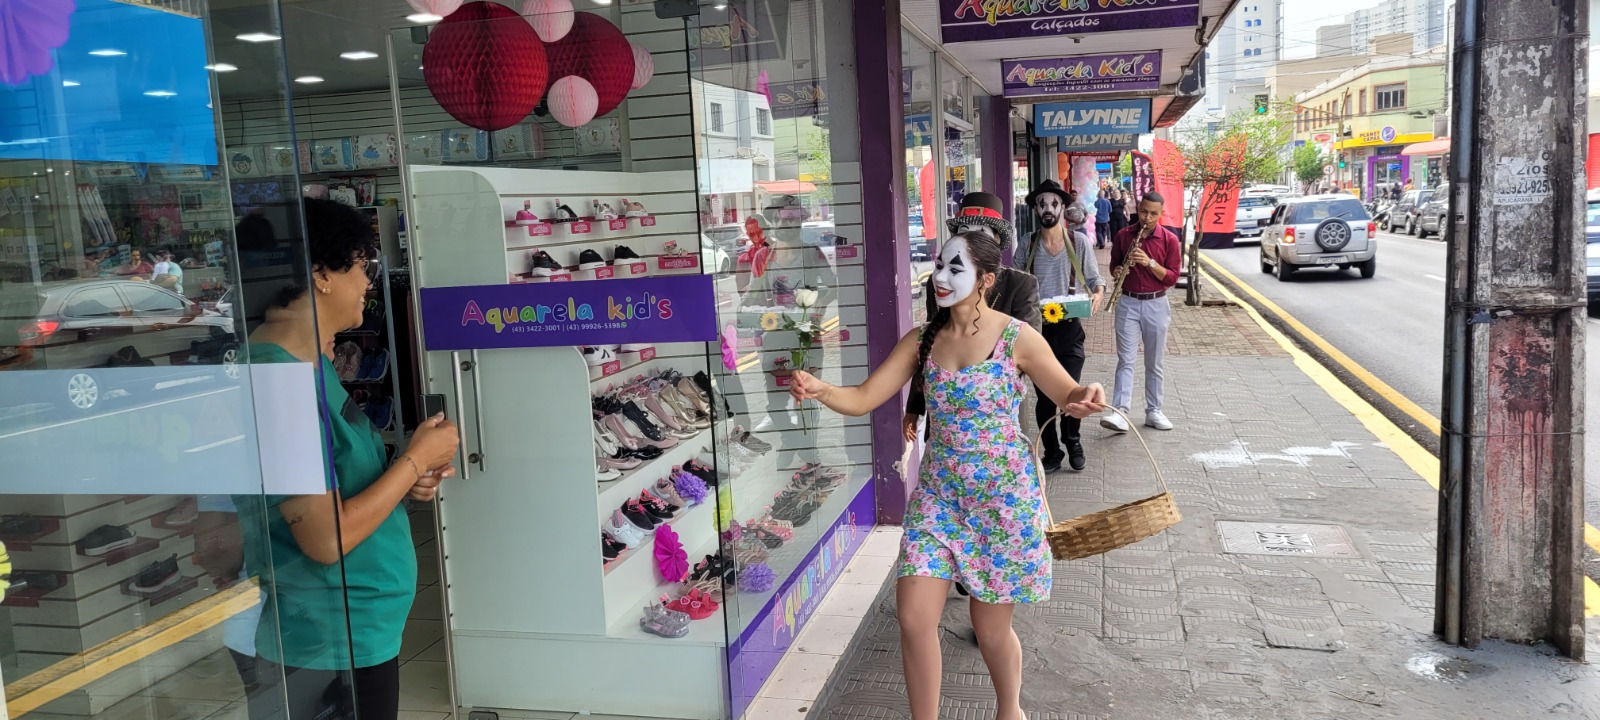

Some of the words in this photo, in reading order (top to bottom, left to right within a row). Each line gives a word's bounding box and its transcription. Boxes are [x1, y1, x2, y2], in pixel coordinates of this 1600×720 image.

[1031, 16, 1100, 32] Calçados
[1006, 61, 1093, 86] Aquarela
[1099, 55, 1153, 77] Kid's
[1042, 108, 1142, 128] TALYNNE
[1064, 133, 1132, 146] TALYNNE
[461, 297, 594, 333] Aquarela
[607, 292, 673, 320] kid's
[526, 324, 560, 332] 3422-3001
[566, 323, 580, 331] (43)
[581, 322, 621, 330] 99926-5398
[773, 542, 832, 646] Aquarela
